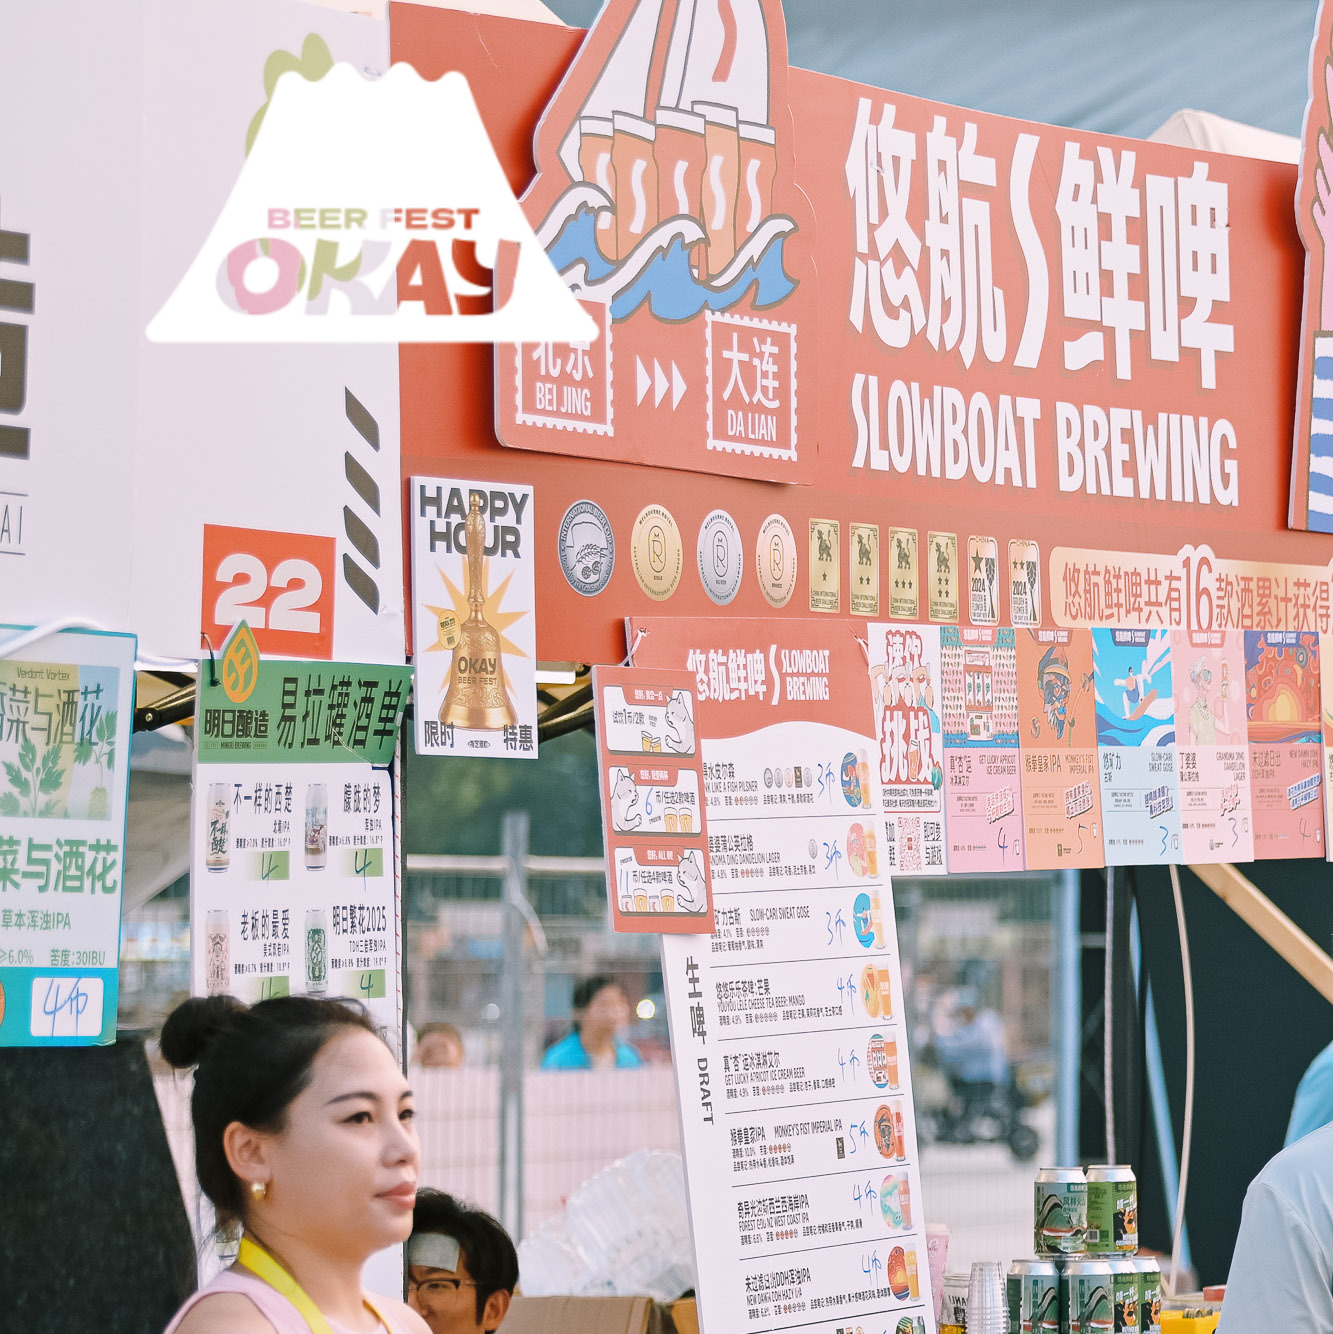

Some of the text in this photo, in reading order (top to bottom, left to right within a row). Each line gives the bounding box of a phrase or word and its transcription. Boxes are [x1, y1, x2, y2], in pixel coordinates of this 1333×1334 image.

[722, 331, 780, 410] 大连
[727, 409, 777, 442] DA LIAN
[852, 374, 1239, 508] SLOWBOAT BREWING
[419, 484, 530, 525] HAPPY
[429, 519, 522, 559] HOUR
[214, 553, 323, 634] 22
[971, 577, 986, 593] 2024
[1012, 580, 1027, 596] 2024
[458, 656, 497, 676] OKAY
[781, 649, 830, 674] SLOWBOAT
[786, 676, 830, 702] BREWING
[204, 708, 269, 740] 明日酿造
[276, 674, 403, 751] 易拉罐酒单
[424, 720, 455, 748] 限时
[503, 723, 534, 752] 特惠
[880, 709, 934, 785] 挑战
[233, 782, 293, 814] 不一样的西楚
[645, 786, 654, 816] 6
[1159, 825, 1169, 857] 3
[240, 908, 290, 941] 老板的最爱
[332, 903, 387, 936] 明日繁花2025
[697, 1057, 714, 1126] DRAFT
